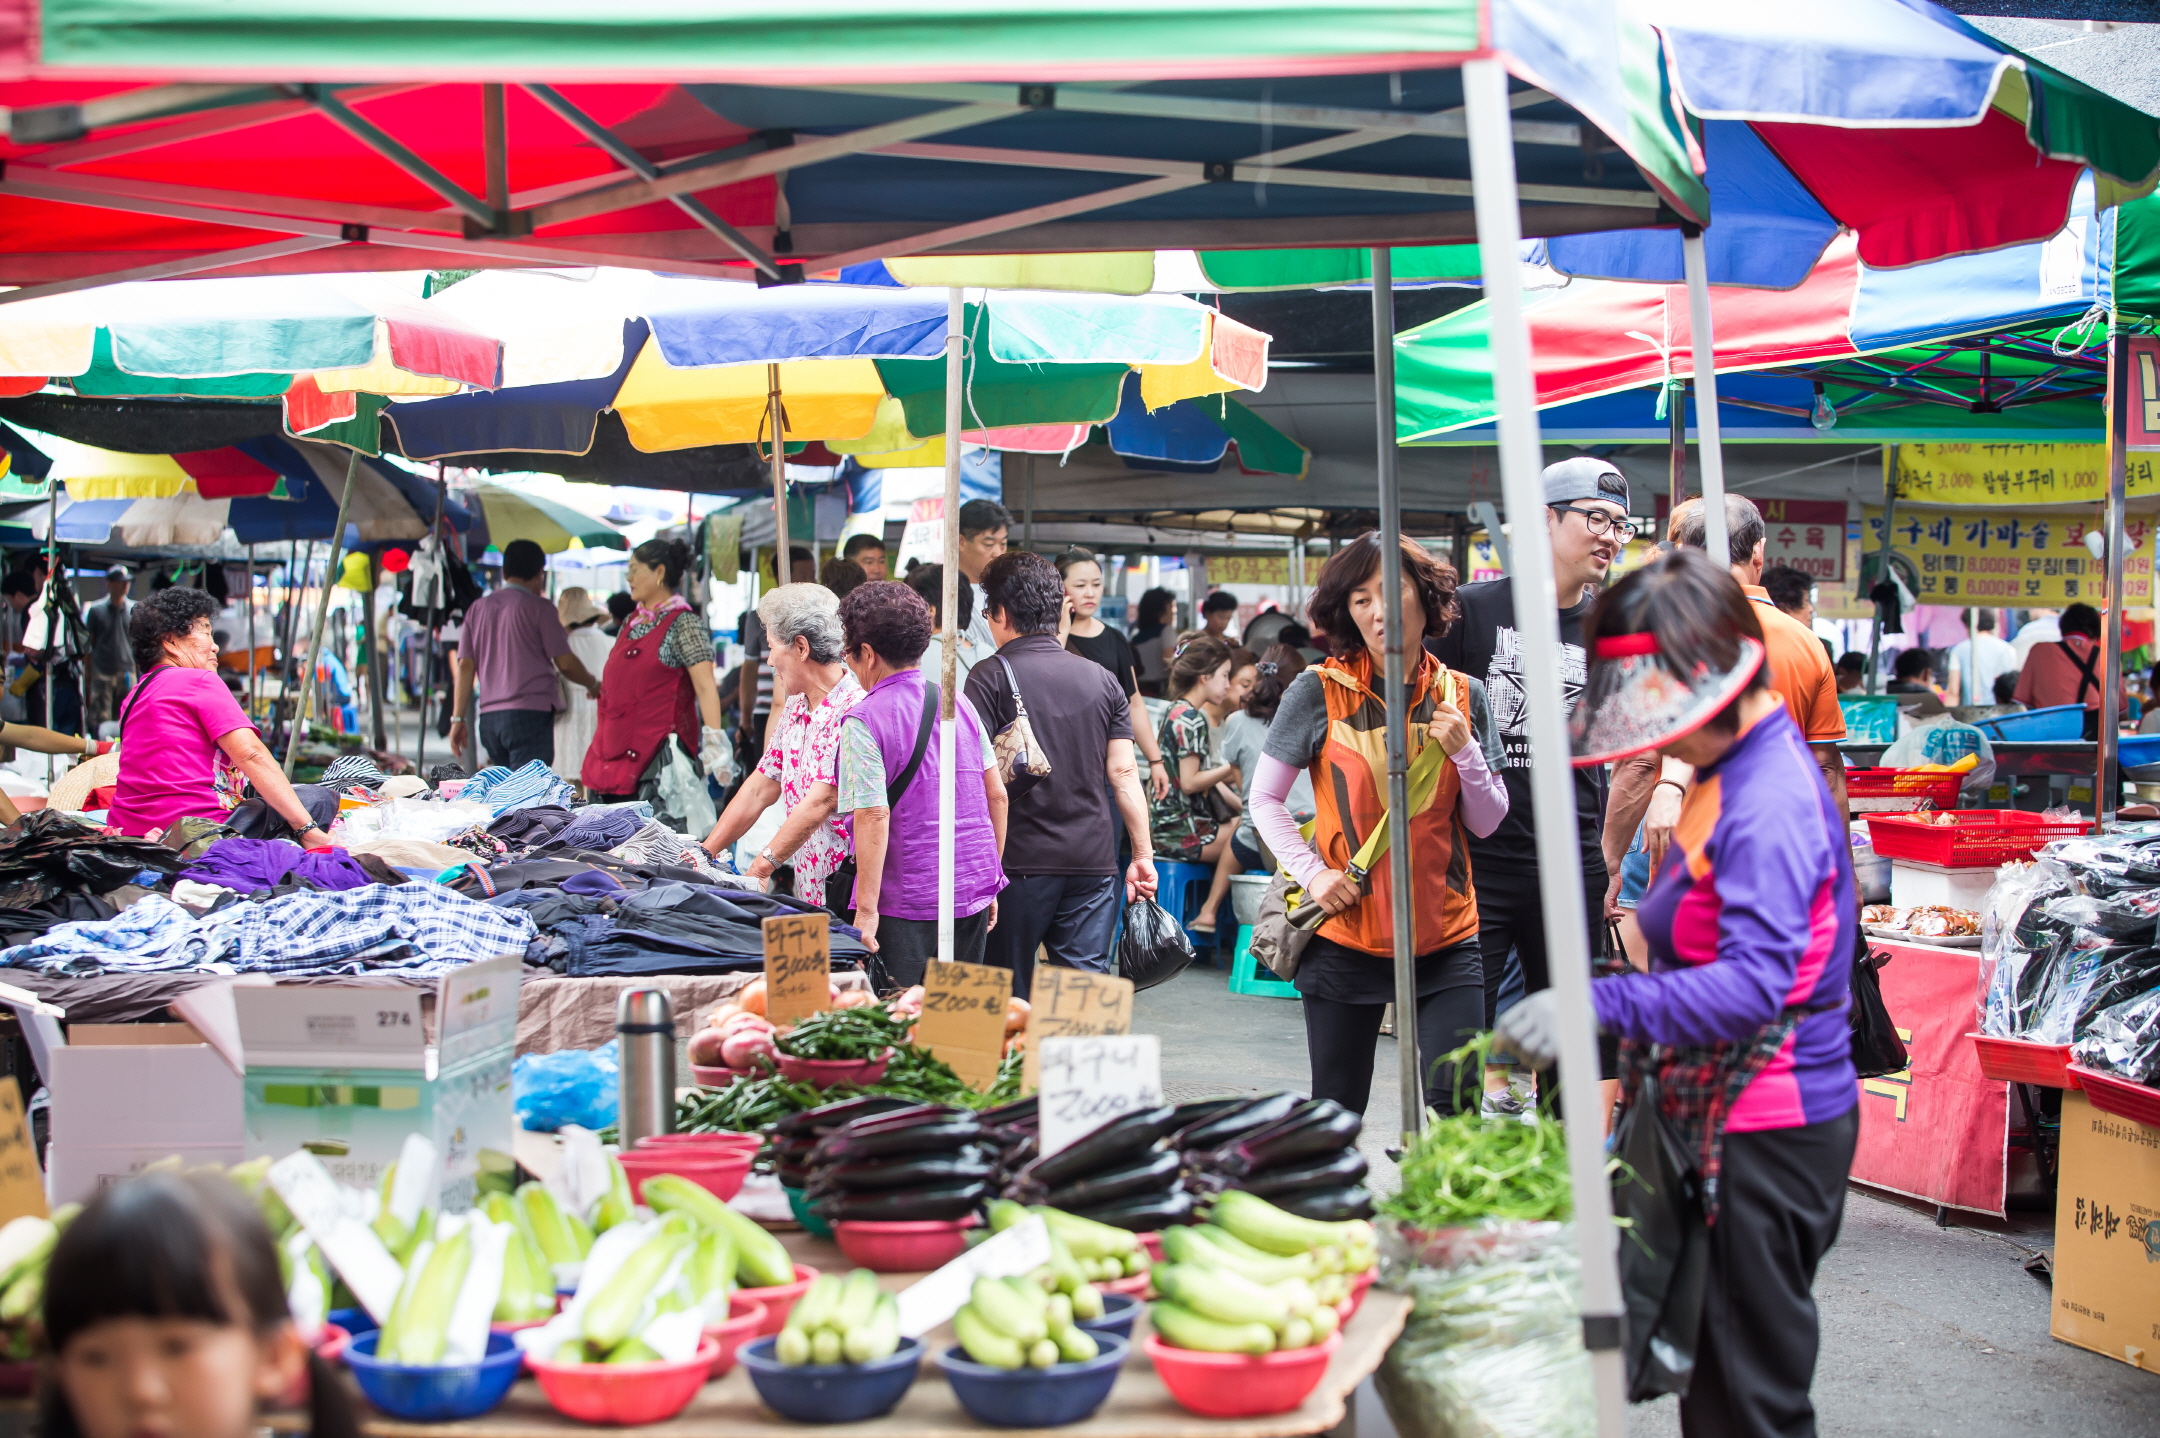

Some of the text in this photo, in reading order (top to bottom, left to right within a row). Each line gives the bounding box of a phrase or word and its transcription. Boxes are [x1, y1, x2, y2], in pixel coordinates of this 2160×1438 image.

[2125, 460, 2153, 487] 걸리
[2061, 521, 2152, 549] 보탕
[1506, 743, 1536, 754] AGIN
[1508, 757, 1536, 768] ISIO
[377, 1011, 412, 1027] 274
